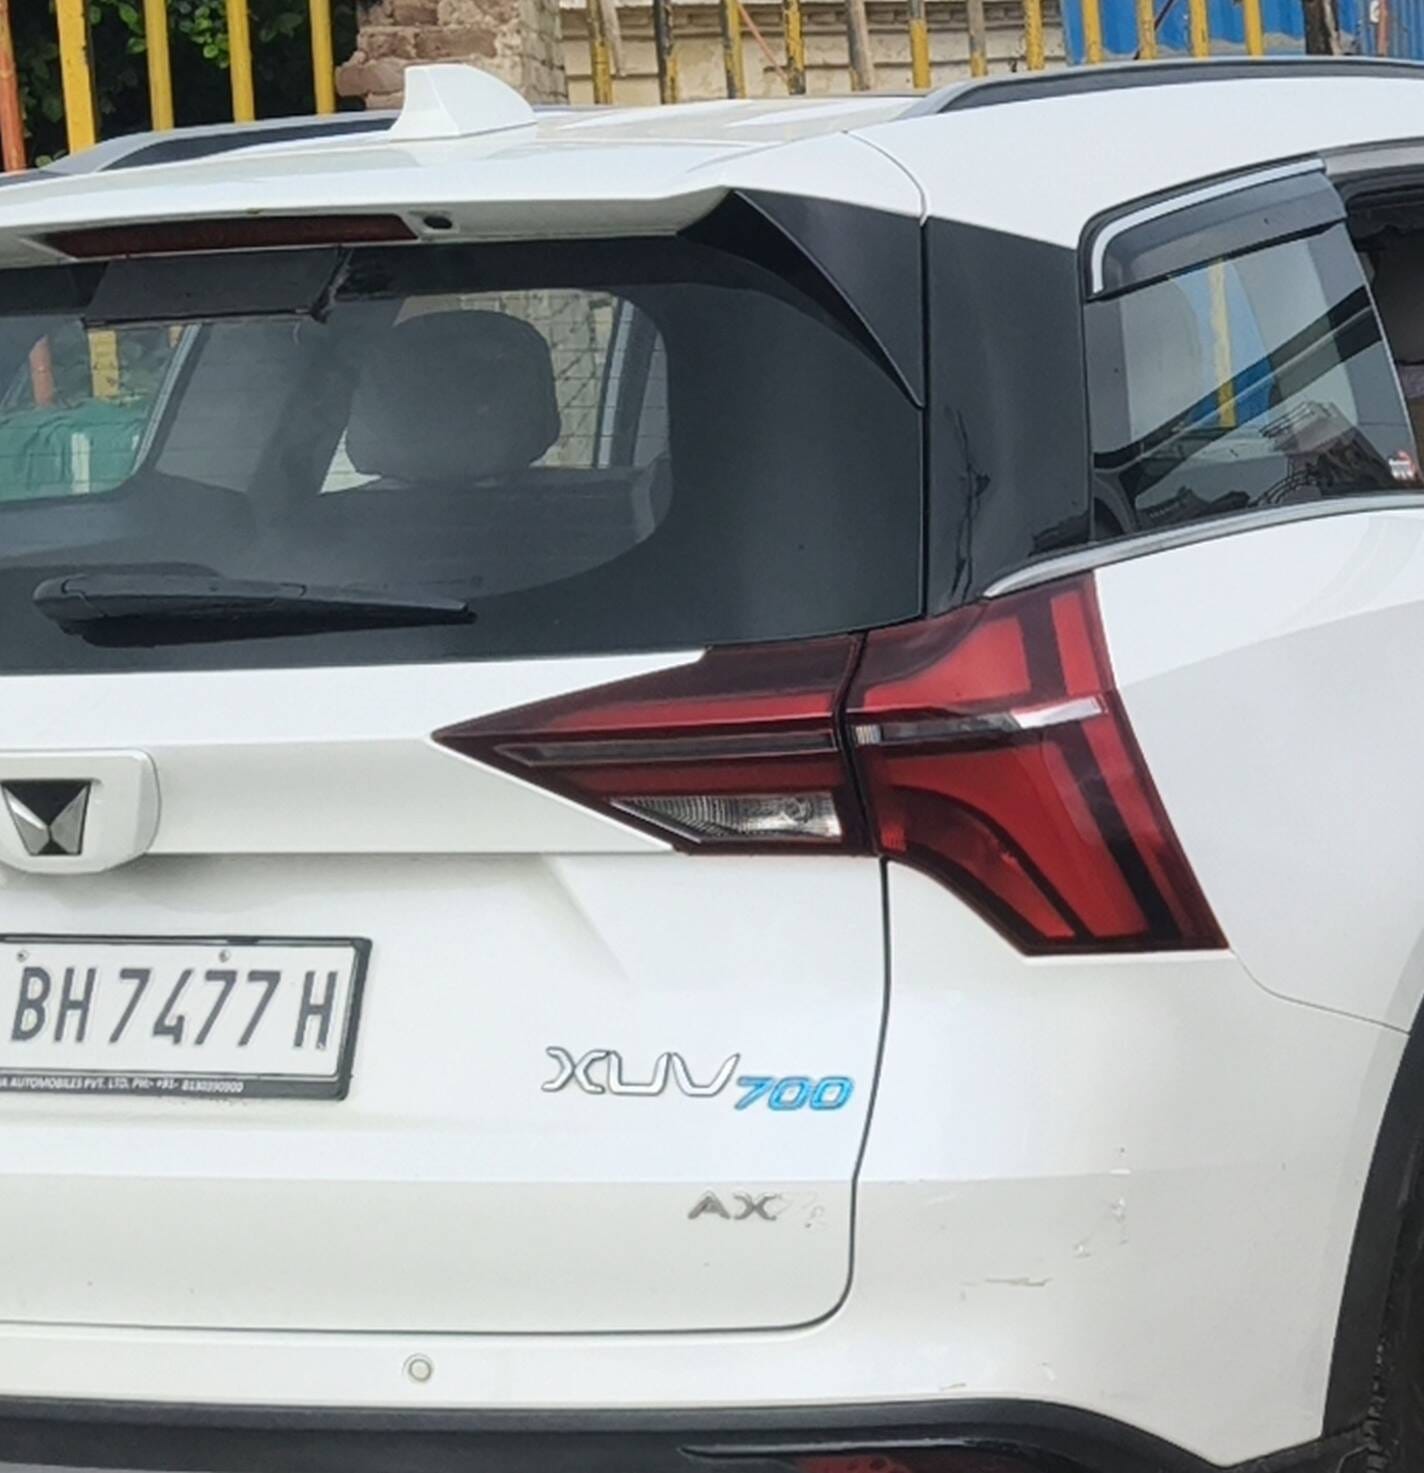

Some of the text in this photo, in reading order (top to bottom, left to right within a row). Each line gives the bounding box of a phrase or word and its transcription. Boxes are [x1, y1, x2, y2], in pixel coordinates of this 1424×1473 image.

[10, 966, 338, 1049] BH 7477 H
